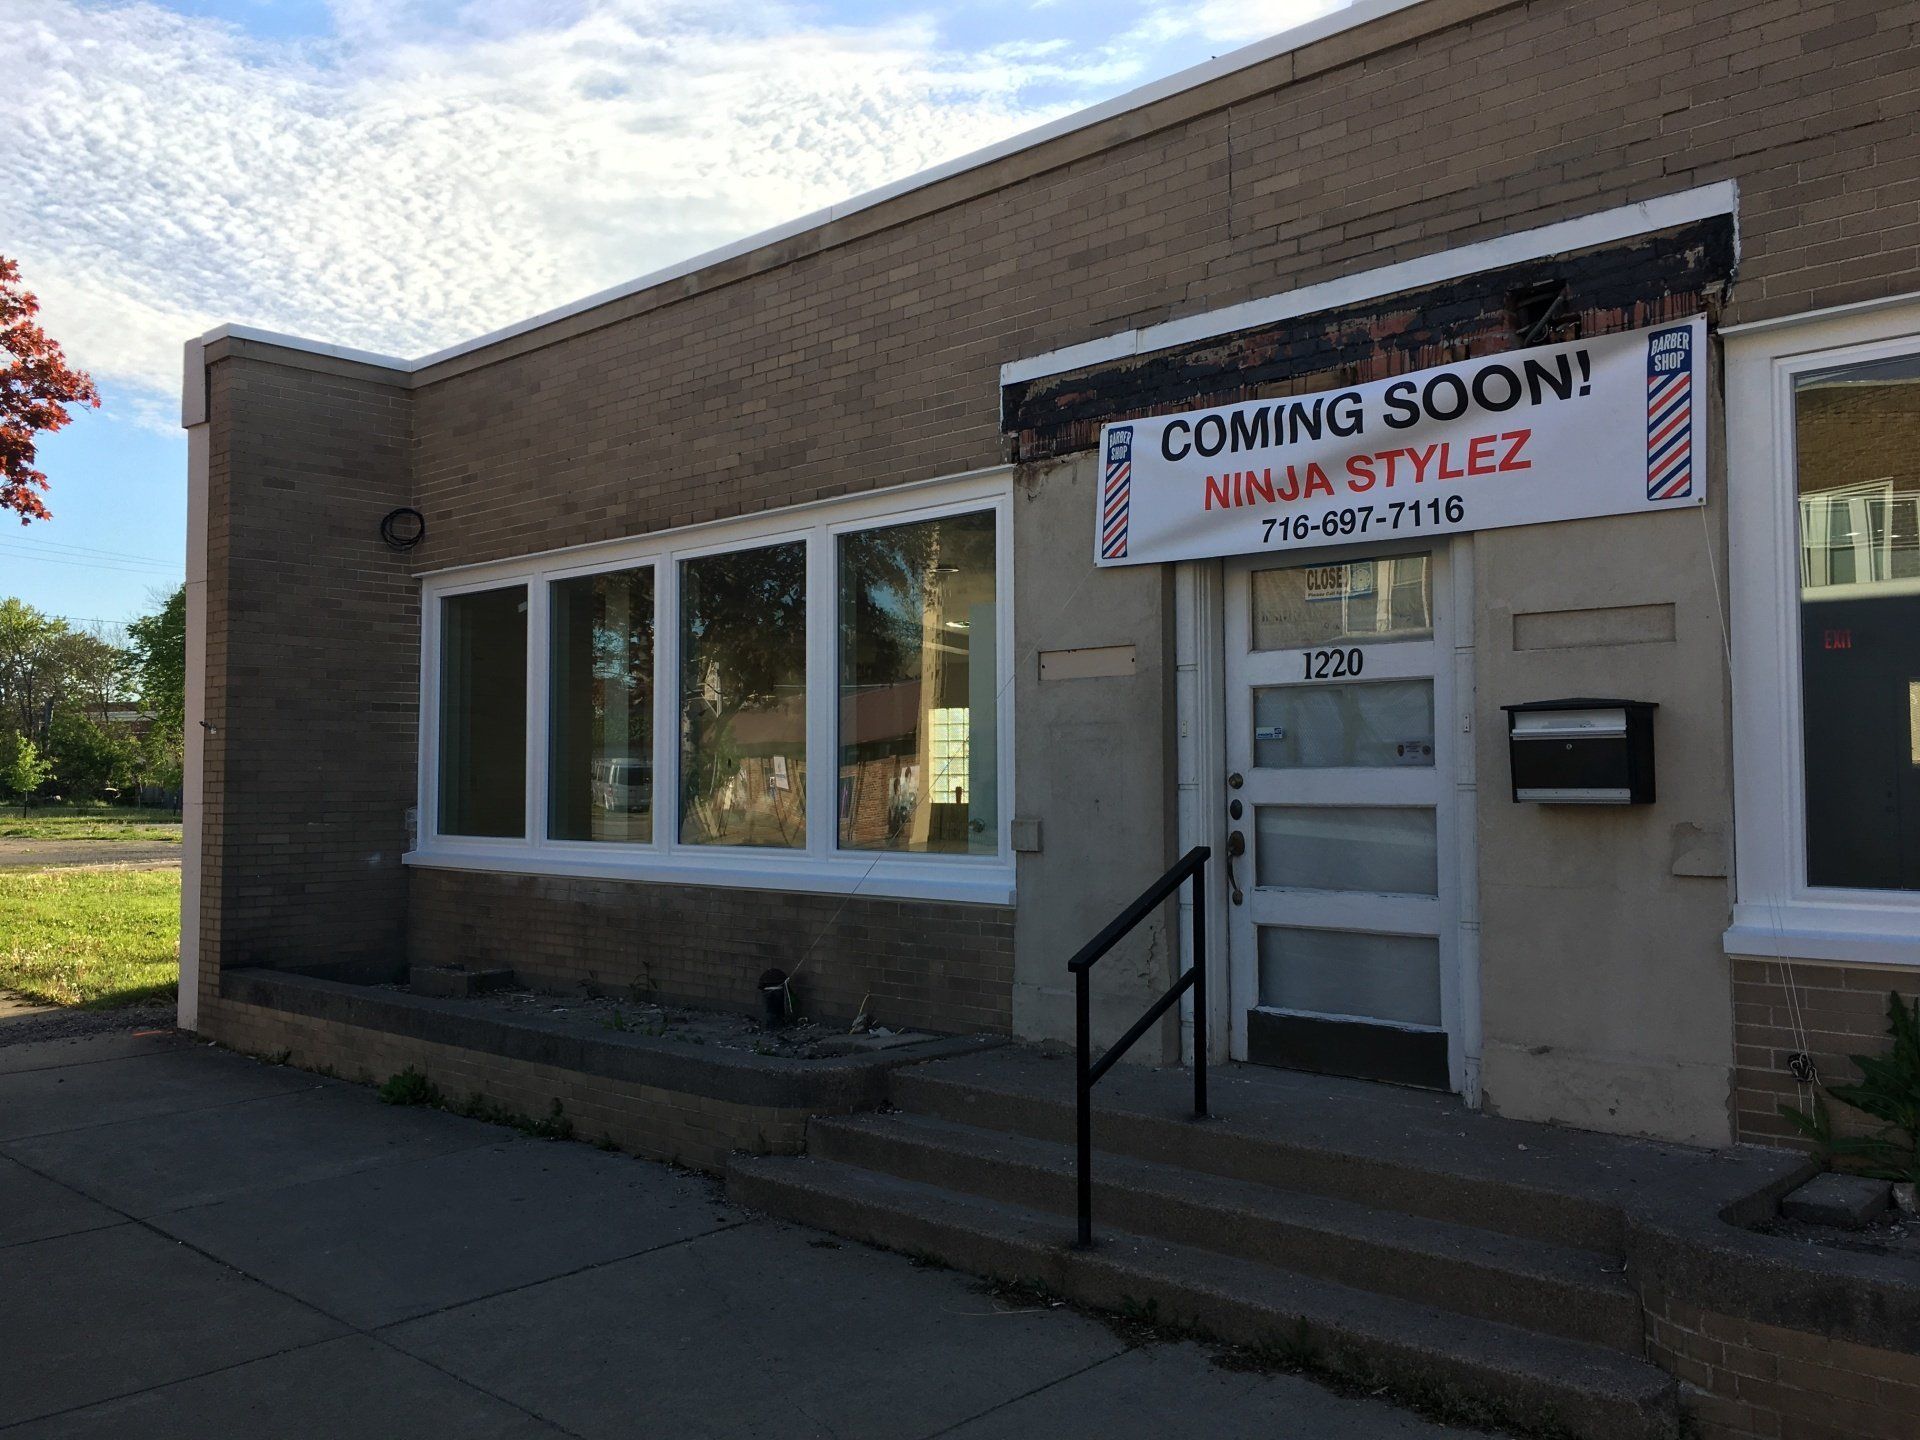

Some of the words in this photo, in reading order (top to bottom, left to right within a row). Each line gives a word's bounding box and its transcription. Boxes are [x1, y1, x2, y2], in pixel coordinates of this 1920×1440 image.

[1651, 331, 1690, 357] BARBER
[1654, 350, 1685, 372] SHOP
[1161, 391, 1364, 462] COMING
[1382, 350, 1592, 430] SOON!
[1109, 430, 1132, 449] BARBER
[1110, 445, 1128, 461] SHOP
[1204, 463, 1333, 510] NINJA
[1345, 429, 1532, 493] STYLEZ
[1262, 495, 1465, 543] 716-697-7116
[1824, 629, 1852, 649] EXIT
[1302, 648, 1364, 680] 1220
